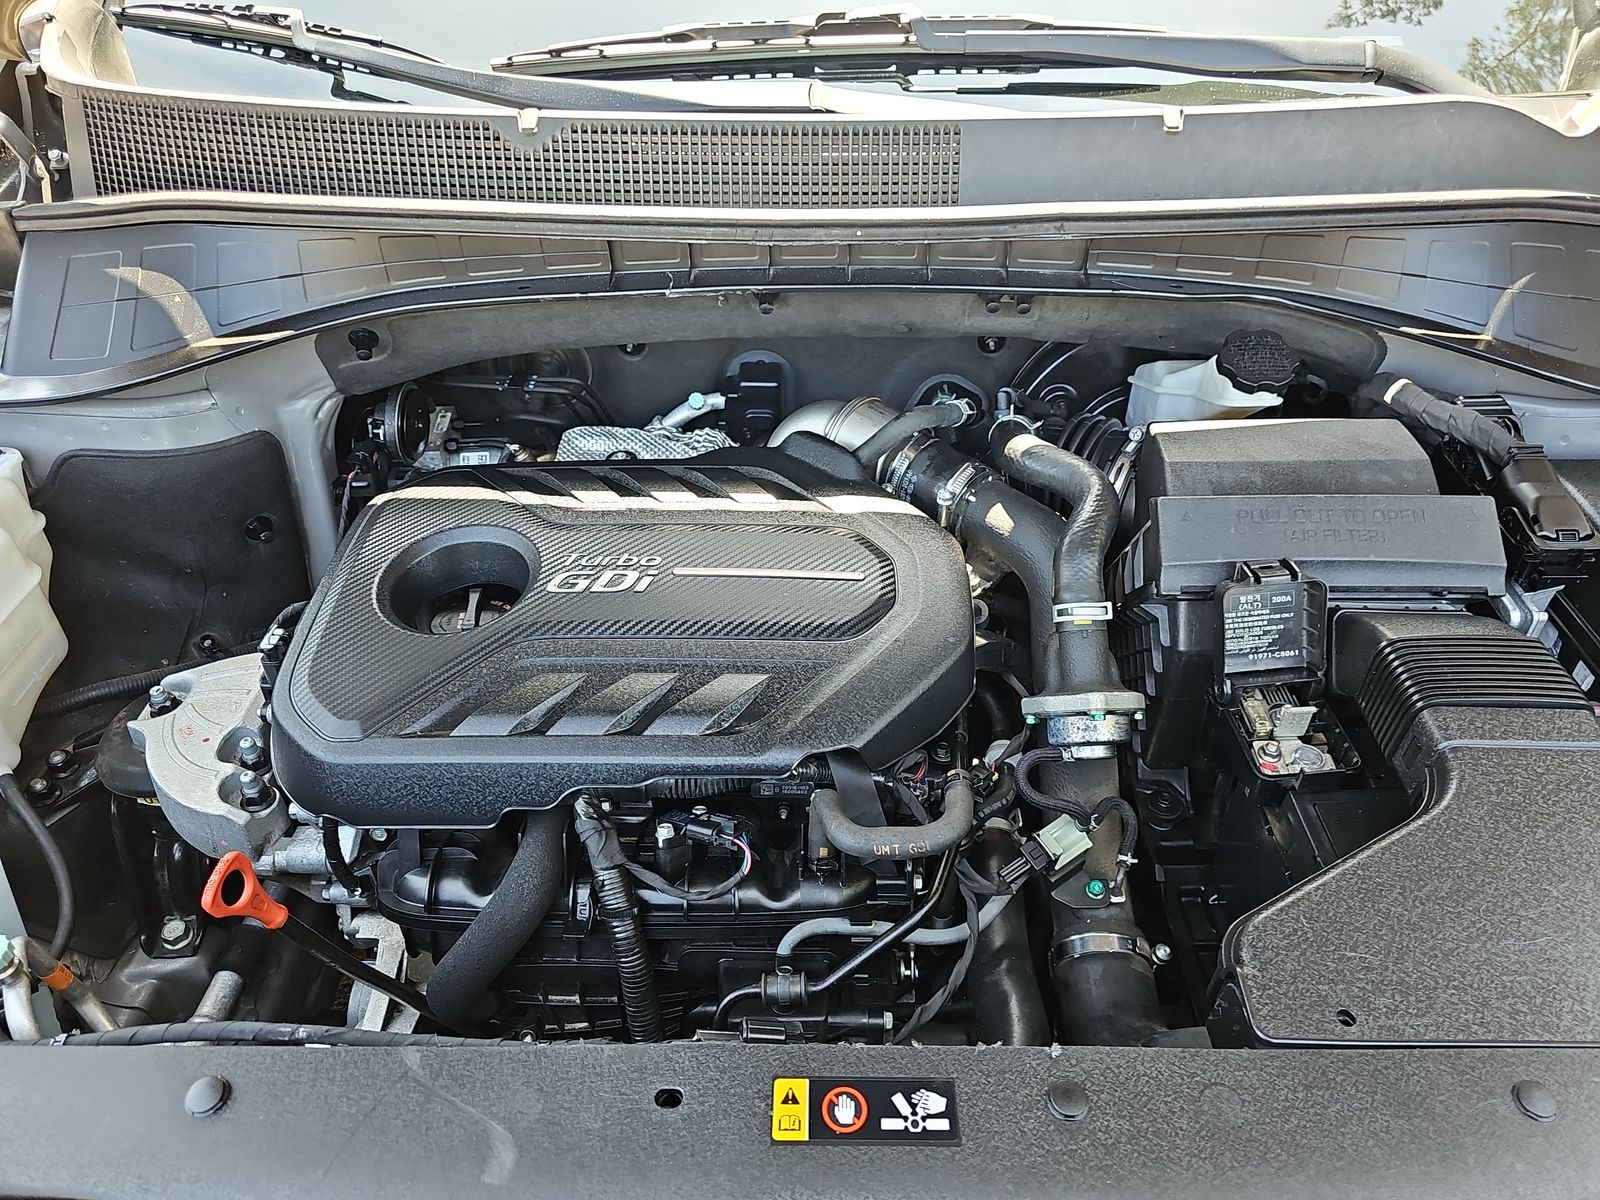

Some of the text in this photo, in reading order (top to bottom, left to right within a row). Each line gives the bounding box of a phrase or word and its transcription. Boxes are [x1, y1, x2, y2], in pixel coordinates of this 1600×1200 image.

[1236, 508, 1289, 524] PULL
[1337, 508, 1366, 524] TO
[1373, 508, 1427, 524] OPEN
[564, 553, 663, 566] Turbo
[546, 570, 660, 593] GDi
[1271, 595, 1292, 603] 200A
[1238, 602, 1262, 611] (ALT)
[1248, 649, 1299, 660] 91971-C5061
